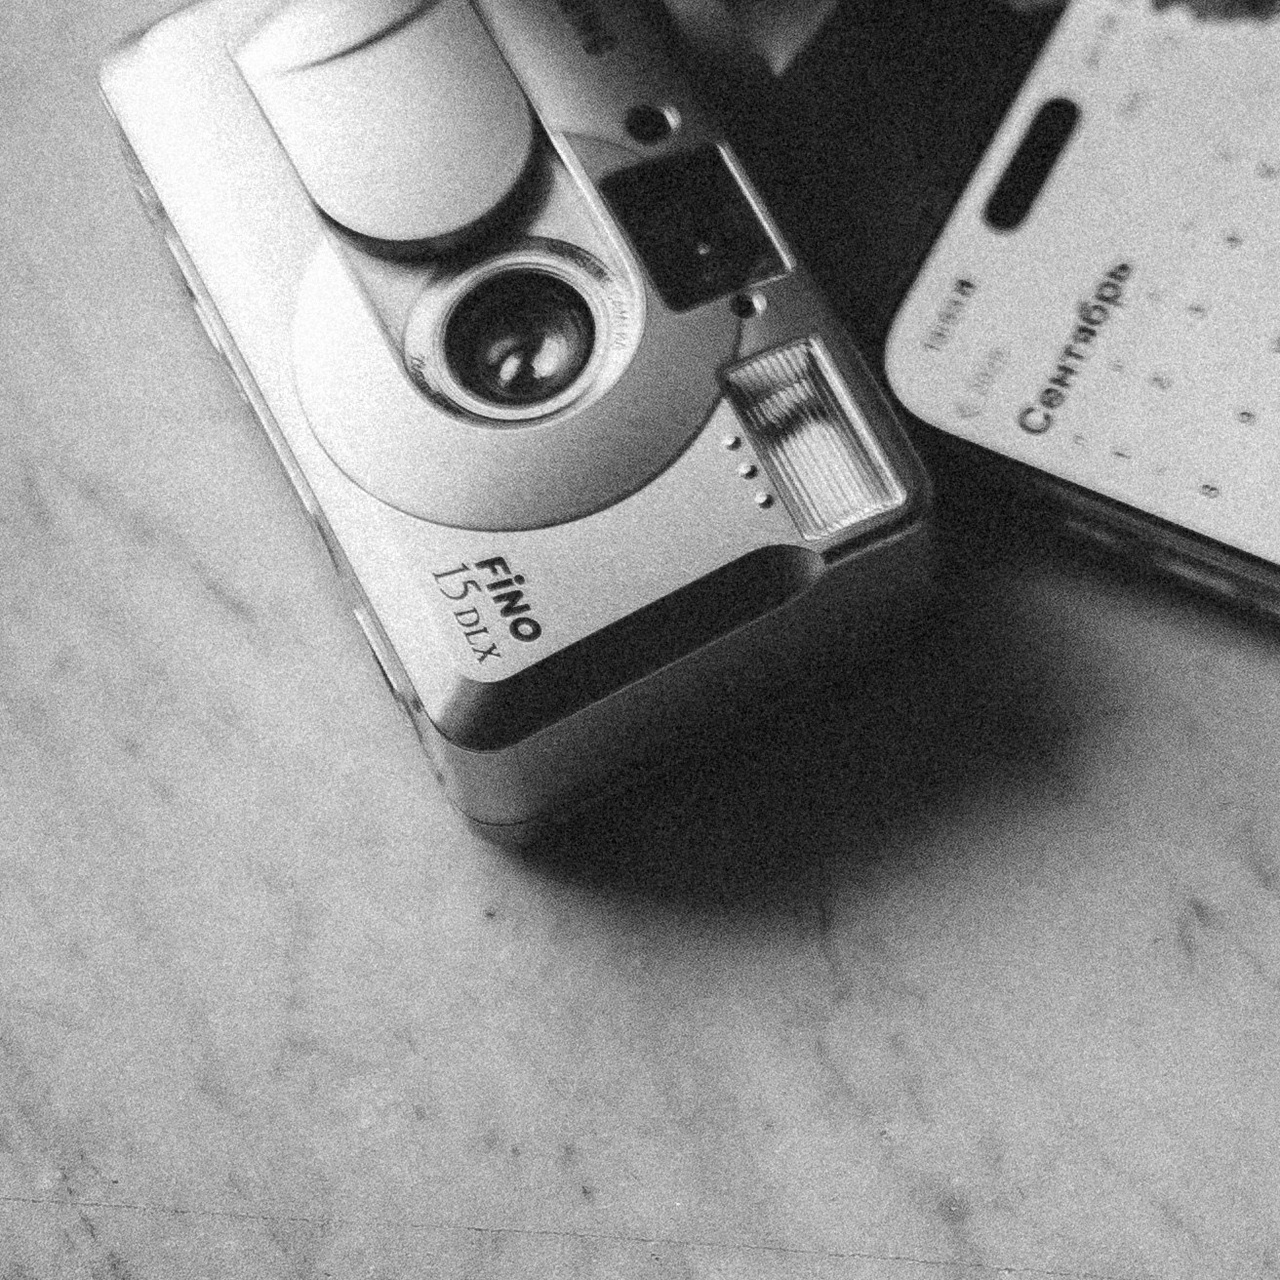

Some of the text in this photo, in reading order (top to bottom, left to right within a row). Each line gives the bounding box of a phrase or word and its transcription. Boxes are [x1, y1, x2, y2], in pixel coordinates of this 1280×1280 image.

[1017, 262, 1133, 435] Сентябрь
[432, 562, 501, 664] 15 DLX
